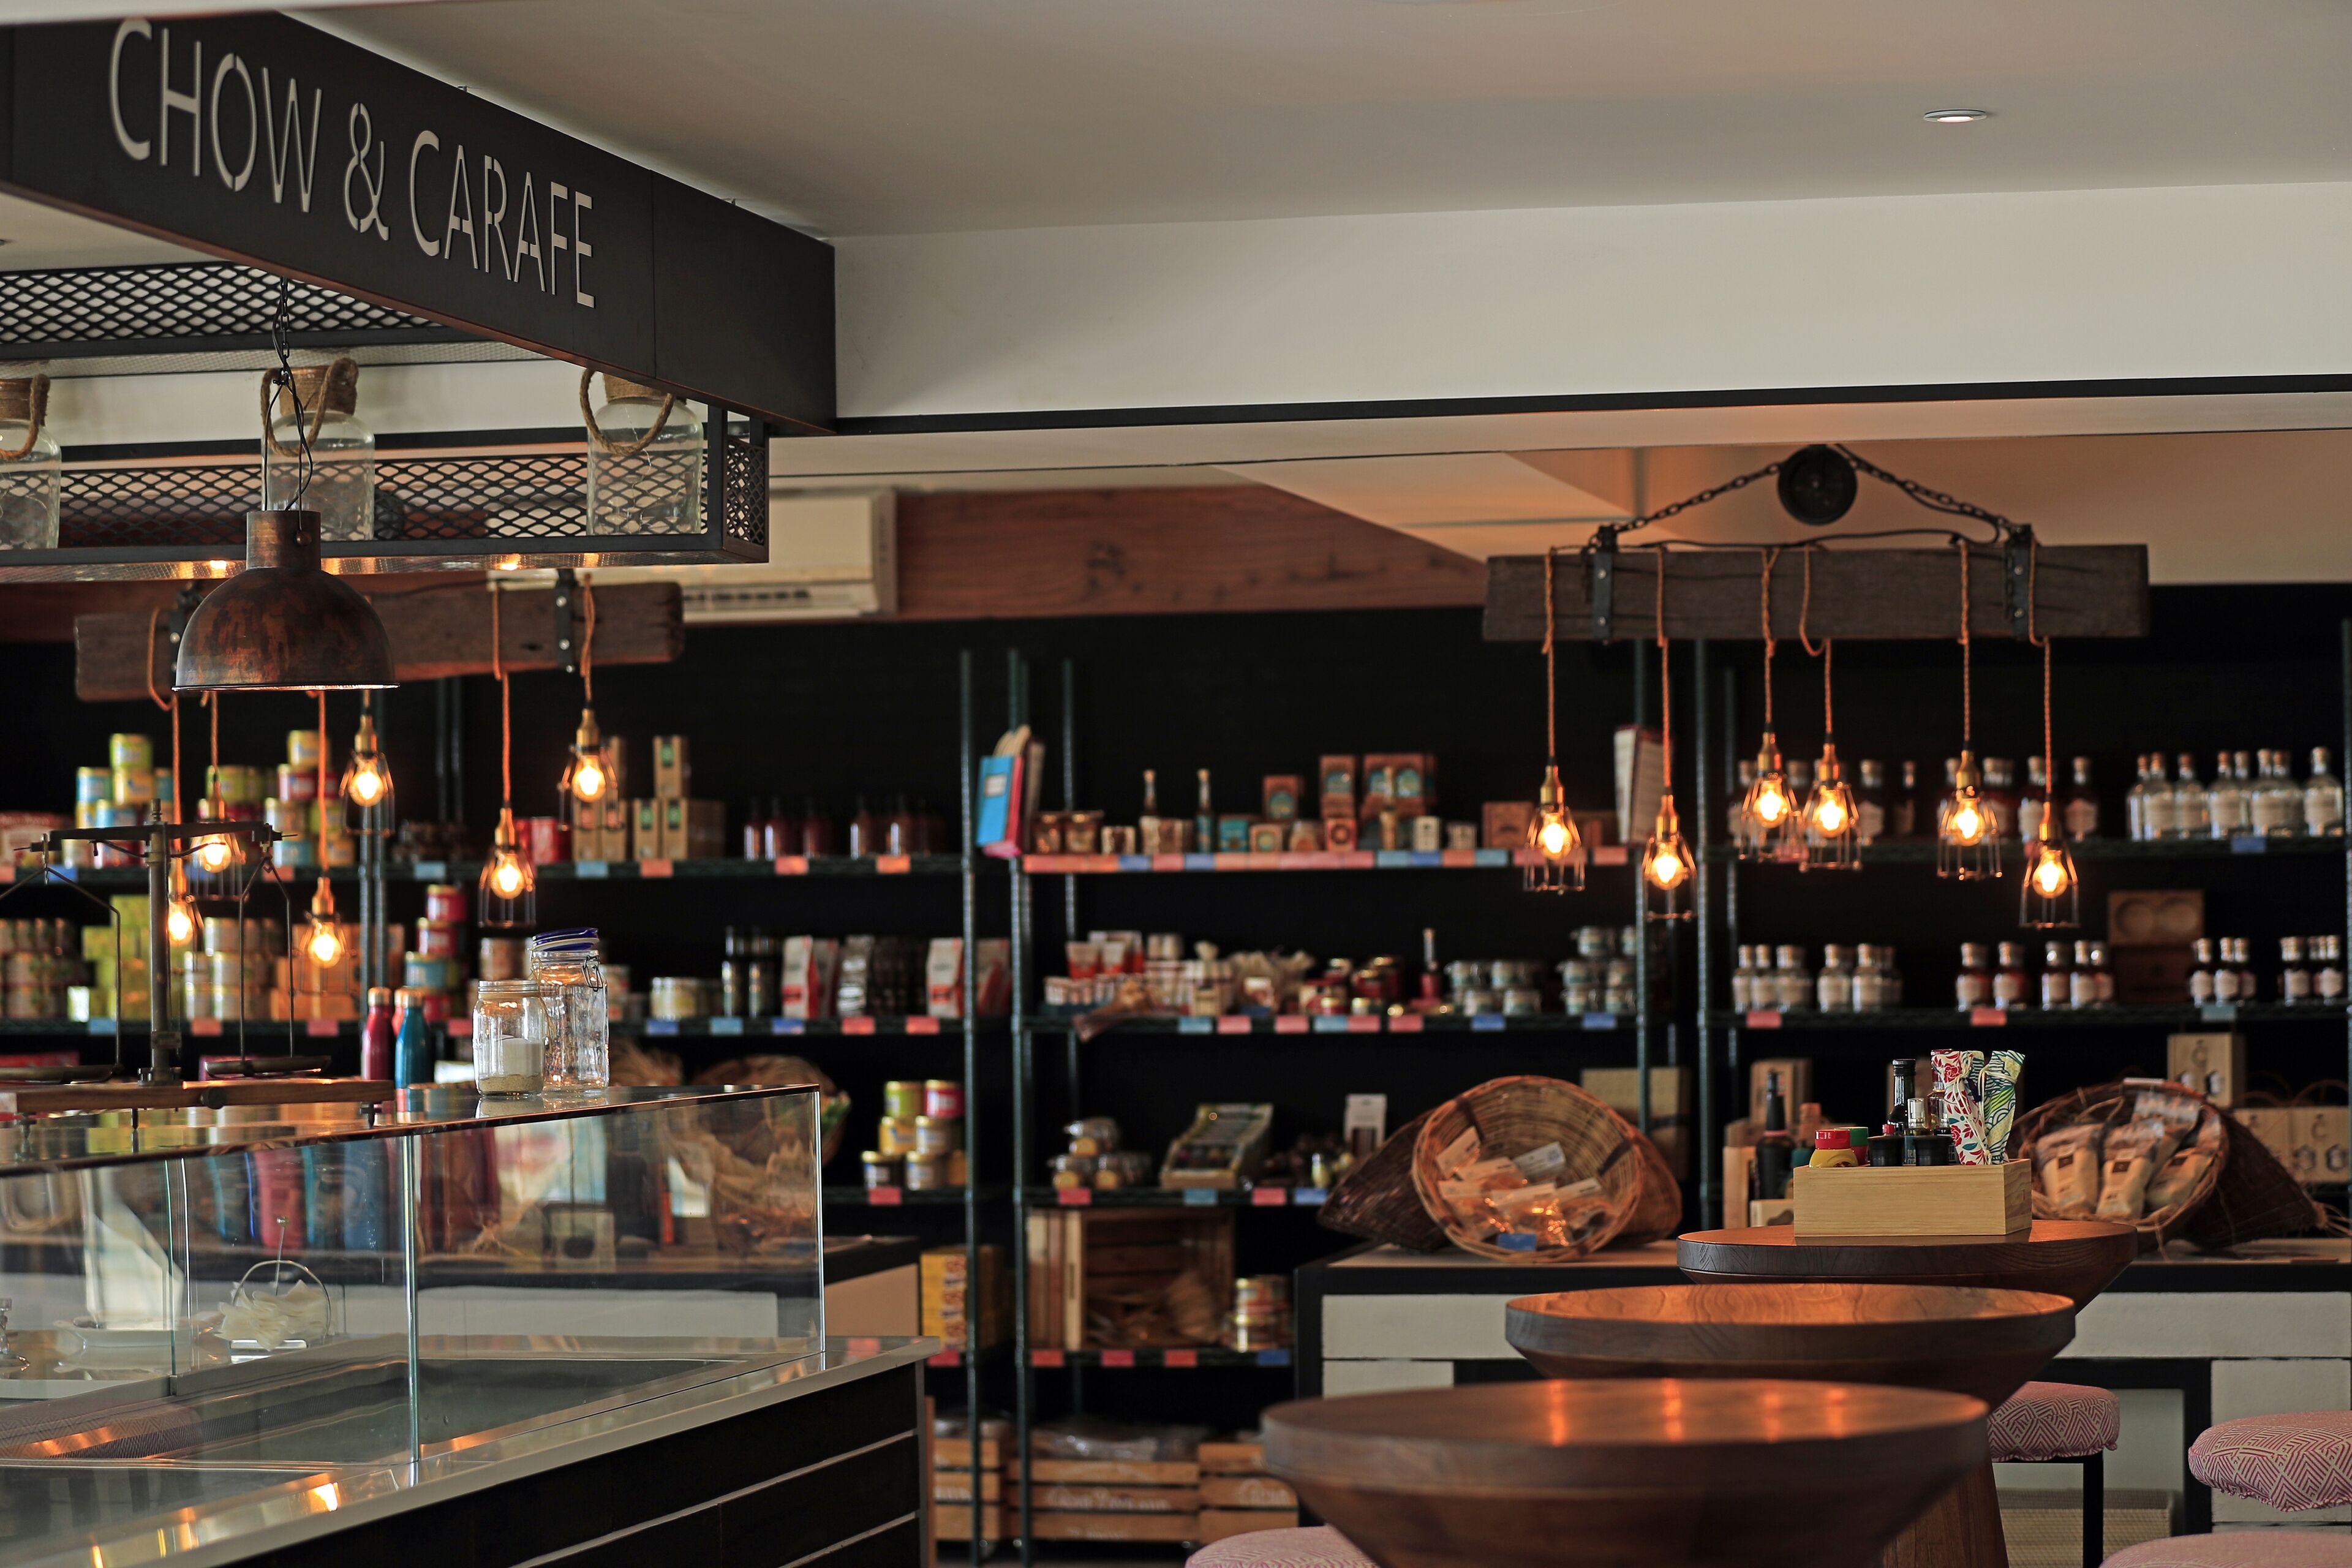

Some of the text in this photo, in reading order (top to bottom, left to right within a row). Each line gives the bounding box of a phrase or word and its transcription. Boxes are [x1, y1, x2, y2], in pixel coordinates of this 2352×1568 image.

[108, 17, 595, 308] CHOW & CARAFE
